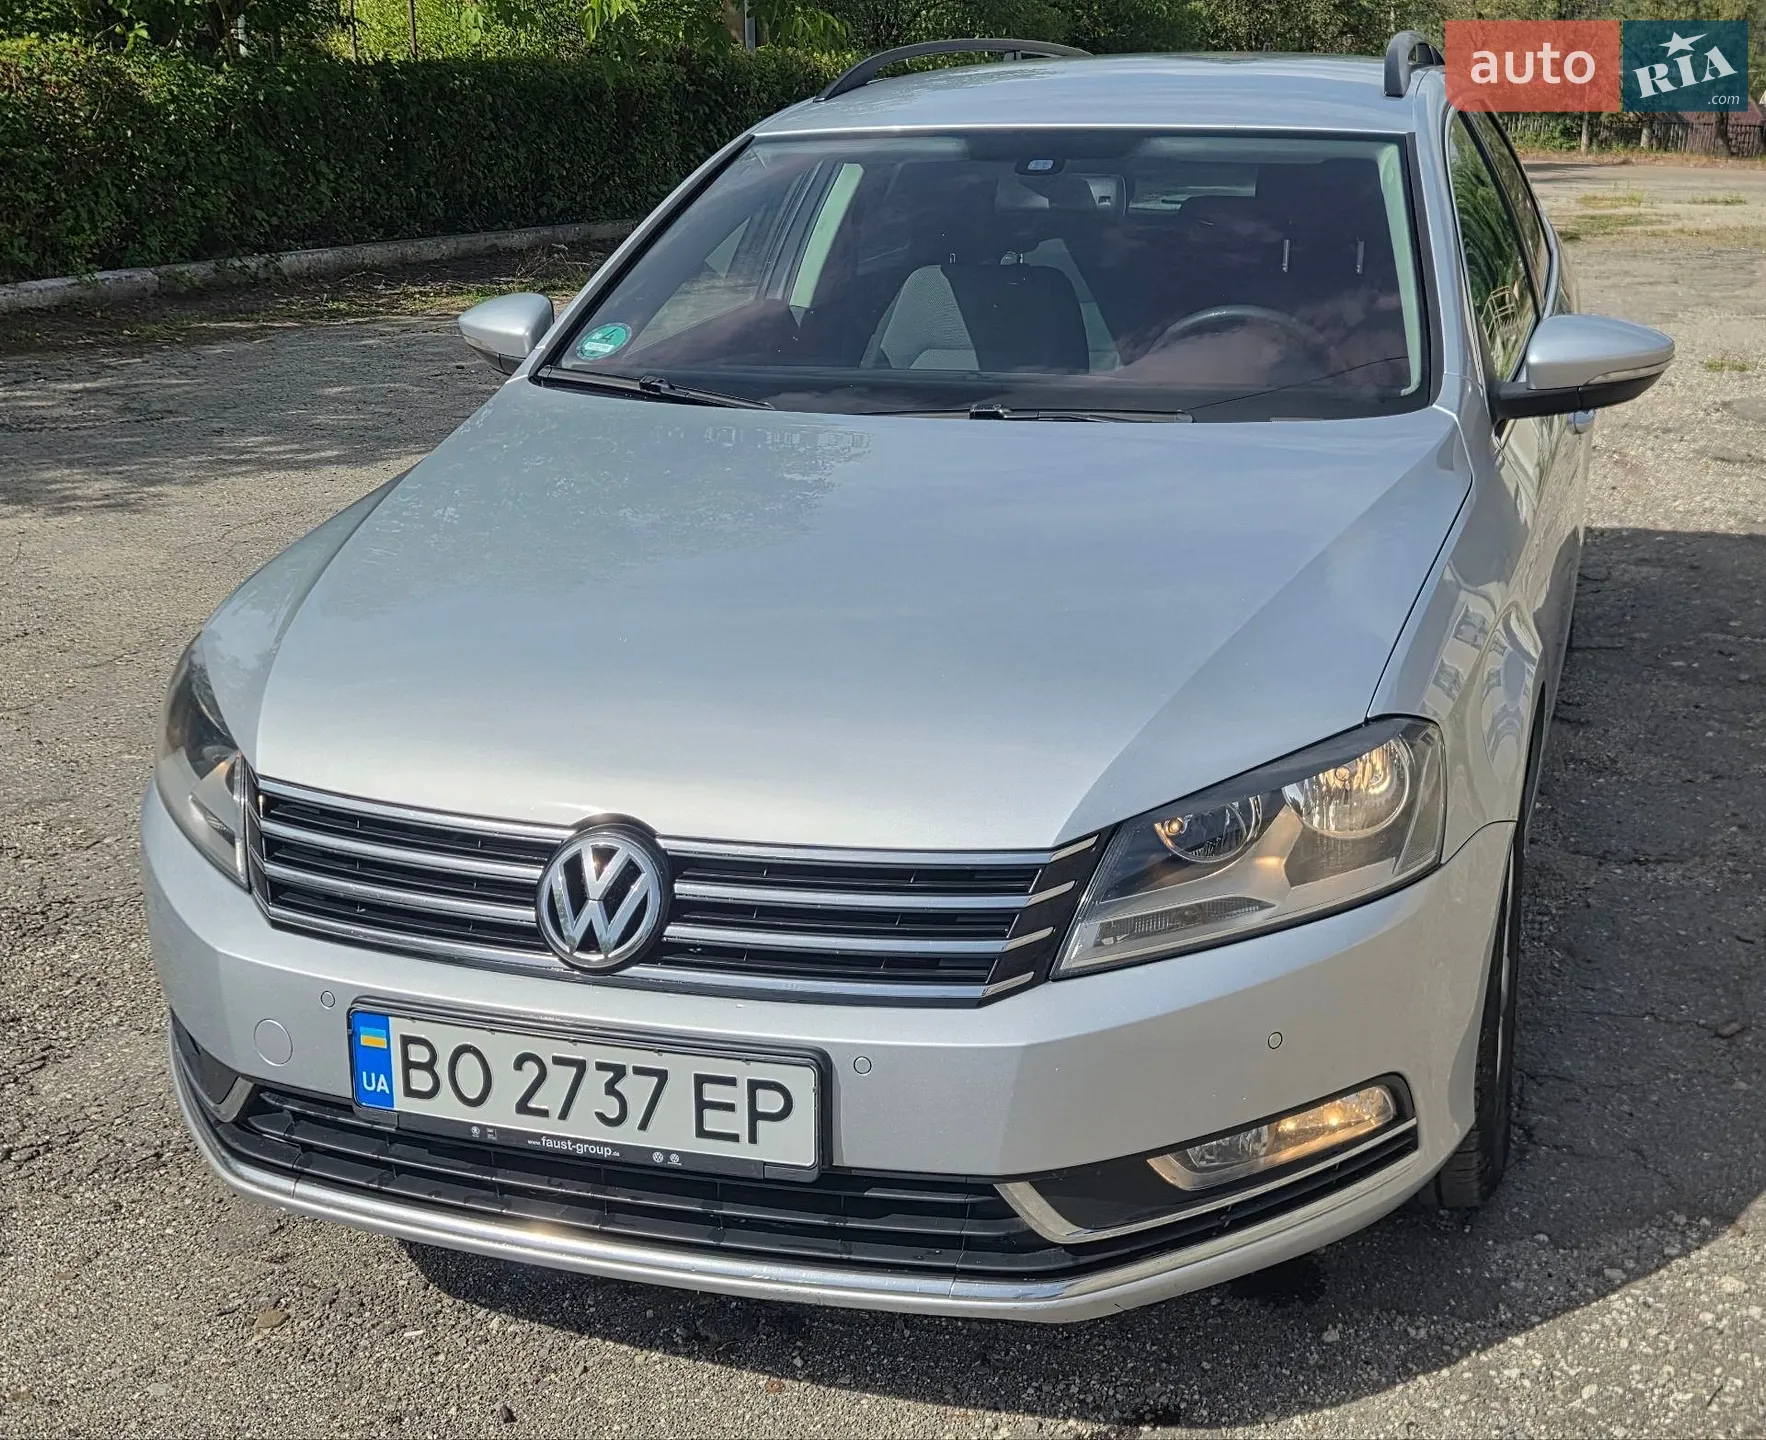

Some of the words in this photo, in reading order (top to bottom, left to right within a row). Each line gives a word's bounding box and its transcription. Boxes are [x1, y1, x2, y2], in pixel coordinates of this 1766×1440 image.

[601, 328, 617, 343] 4
[362, 1071, 390, 1095] UA
[399, 1033, 493, 1108] BO
[512, 1050, 669, 1132] 2737
[692, 1072, 794, 1145] EP
